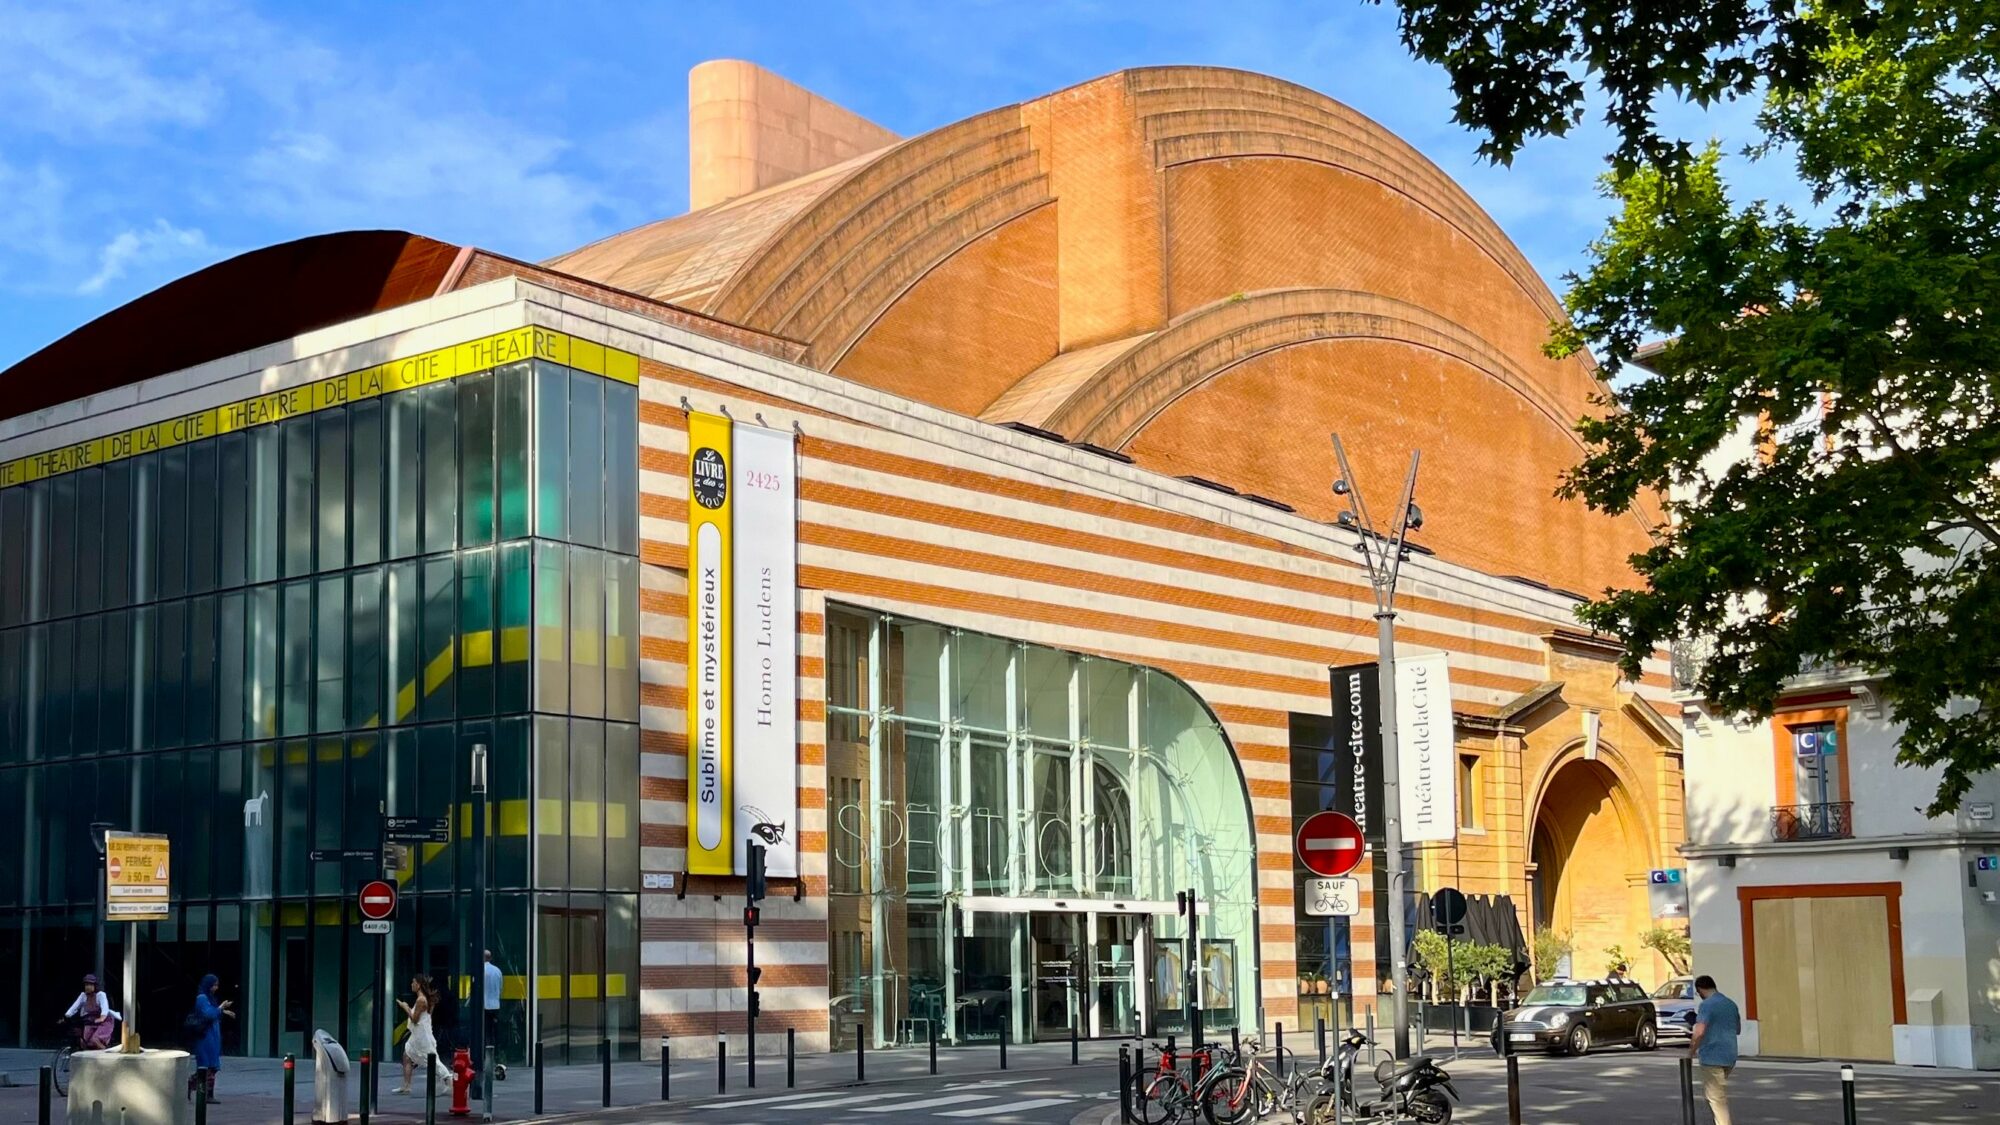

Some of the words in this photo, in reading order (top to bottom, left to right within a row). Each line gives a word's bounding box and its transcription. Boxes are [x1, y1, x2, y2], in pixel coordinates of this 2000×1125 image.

[112, 434, 131, 458] DE
[140, 428, 158, 450] LA
[325, 378, 347, 405] DE
[360, 371, 381, 395] LA
[703, 450, 716, 462] Le
[695, 459, 724, 480] LIVRE
[746, 470, 780, 491] 2425
[694, 477, 725, 508] MASQUES
[702, 478, 716, 488] des
[757, 567, 771, 647] Ludens
[702, 568, 717, 683] mystérieux
[703, 689, 715, 711] et
[757, 657, 772, 728] Homo
[702, 717, 715, 803] Sublime
[1348, 672, 1367, 834] heatre-cite.com
[1411, 666, 1432, 831] ThéâtredelaCité
[125, 854, 152, 867] FERMÉE
[127, 872, 132, 882] à
[133, 872, 141, 882] 50
[1317, 881, 1345, 890] SAUF
